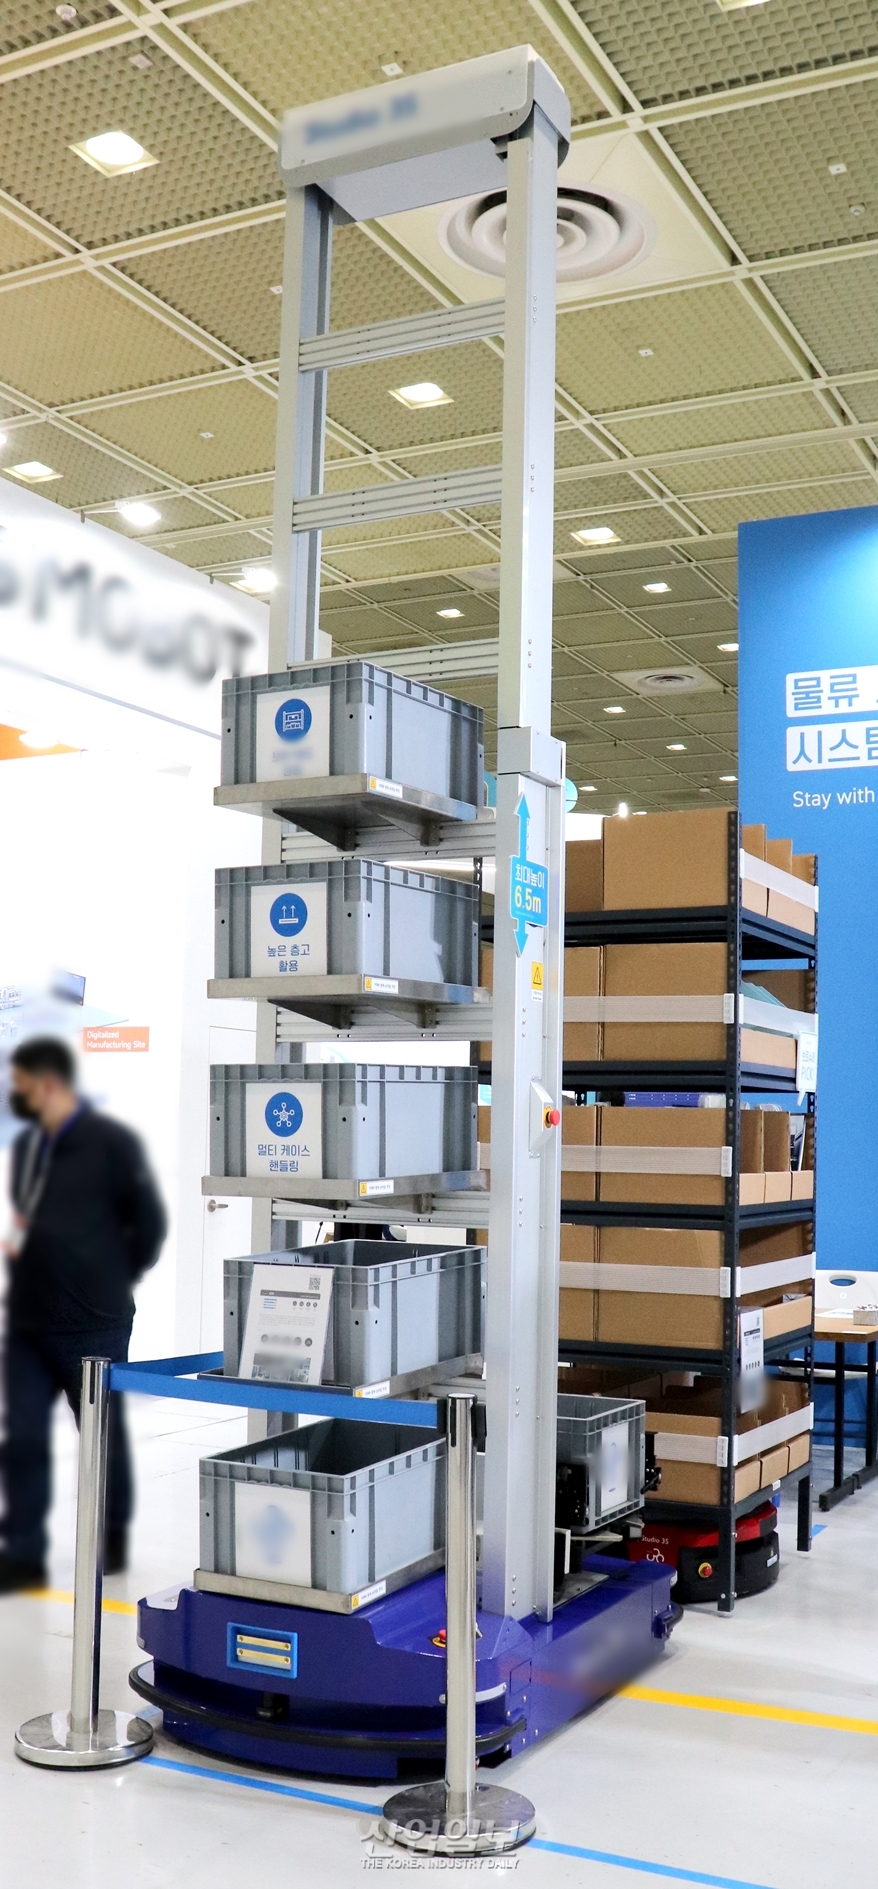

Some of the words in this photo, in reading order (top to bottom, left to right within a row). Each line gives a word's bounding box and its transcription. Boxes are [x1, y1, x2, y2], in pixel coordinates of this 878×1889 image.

[791, 673, 860, 711] 물류
[792, 790, 832, 810] Stay
[836, 786, 875, 805] with
[514, 863, 545, 890] 최대높이
[514, 885, 542, 914] 6.5m
[267, 944, 287, 957] 높은
[290, 943, 310, 956] 층고
[279, 960, 298, 972] 활용
[87, 1030, 120, 1040] Digitalized
[86, 1040, 131, 1050] Manufacturing
[133, 1040, 146, 1049] Site
[257, 1144, 277, 1156] 멀티
[281, 1144, 310, 1157] 케이스
[269, 1160, 299, 1172] 핸들링
